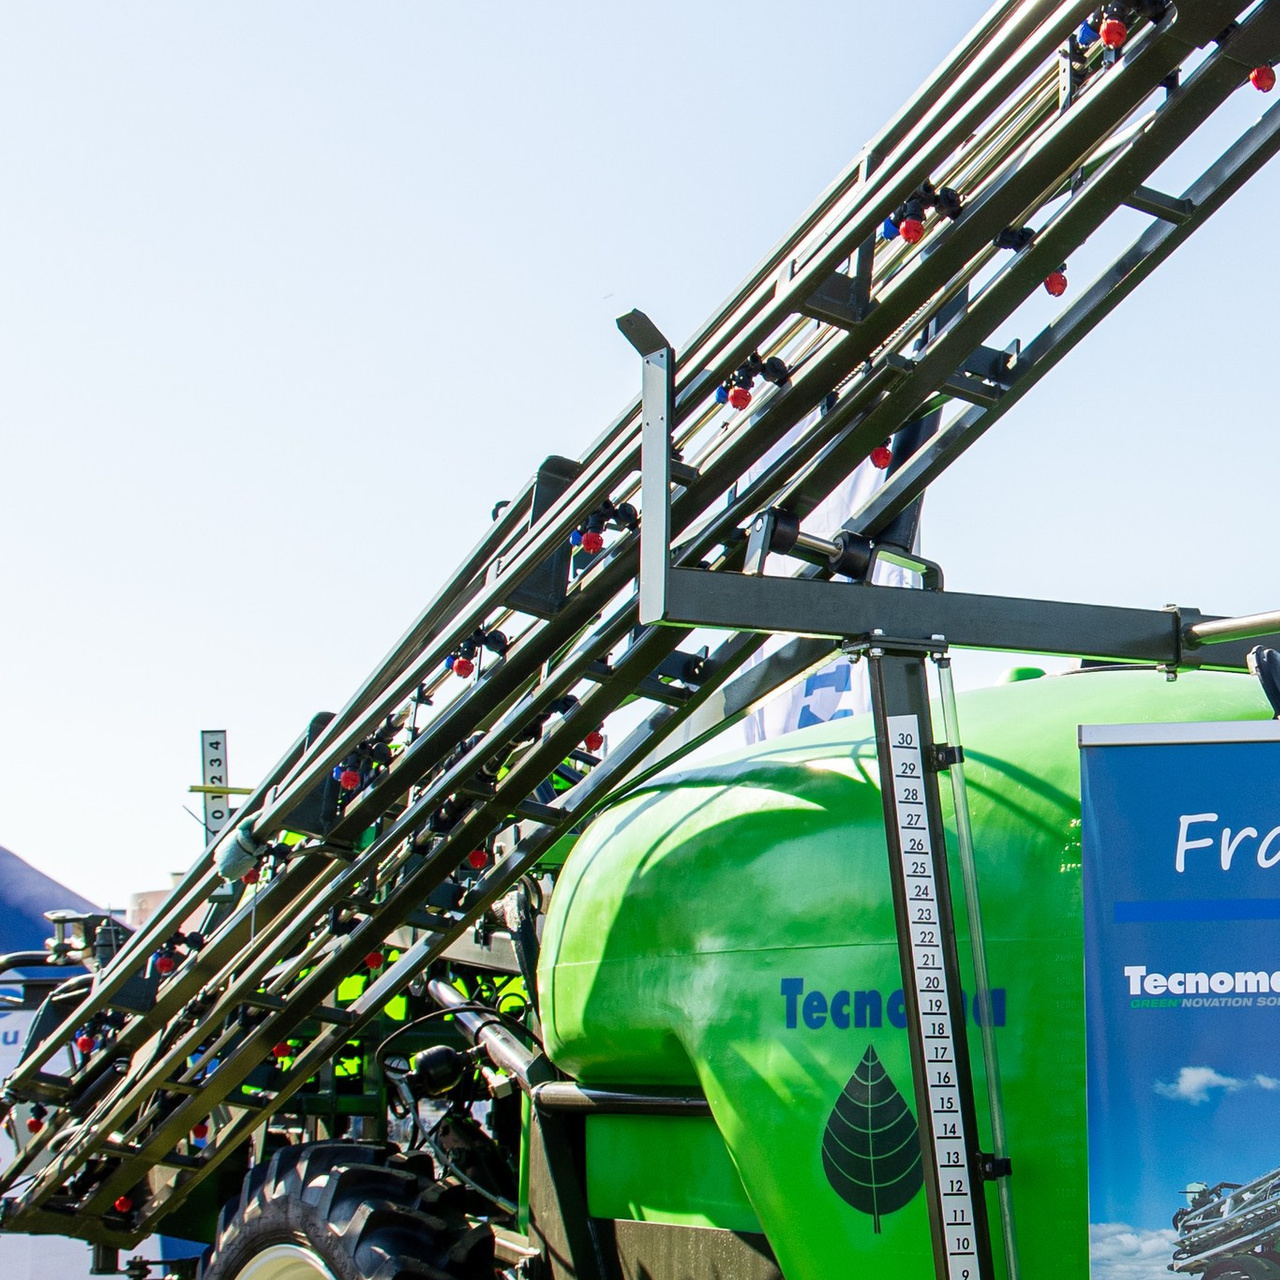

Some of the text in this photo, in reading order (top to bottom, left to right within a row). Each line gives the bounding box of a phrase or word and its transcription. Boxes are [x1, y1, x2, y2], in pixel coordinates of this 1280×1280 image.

[898, 733, 912, 745] 30
[209, 740, 221, 751] 4
[209, 757, 222, 767] 3
[901, 763, 915, 774] 29
[904, 789, 918, 800] 28
[906, 814, 920, 825] 27
[909, 839, 923, 850] 26
[911, 862, 926, 873] 25
[914, 885, 929, 897] 24
[917, 909, 931, 920] 23
[920, 932, 934, 943] 22
[922, 954, 936, 965] 21
[925, 977, 939, 988] 20
[928, 1000, 942, 1011] 19
[931, 1023, 945, 1035] 18
[934, 1047, 947, 1058] 17
[937, 1072, 950, 1083] 16
[940, 1097, 953, 1109] 15
[943, 1124, 956, 1135] 14
[946, 1152, 960, 1164] 13
[949, 1180, 963, 1192] 12
[953, 1210, 965, 1222] 11
[956, 1238, 969, 1250] 10
